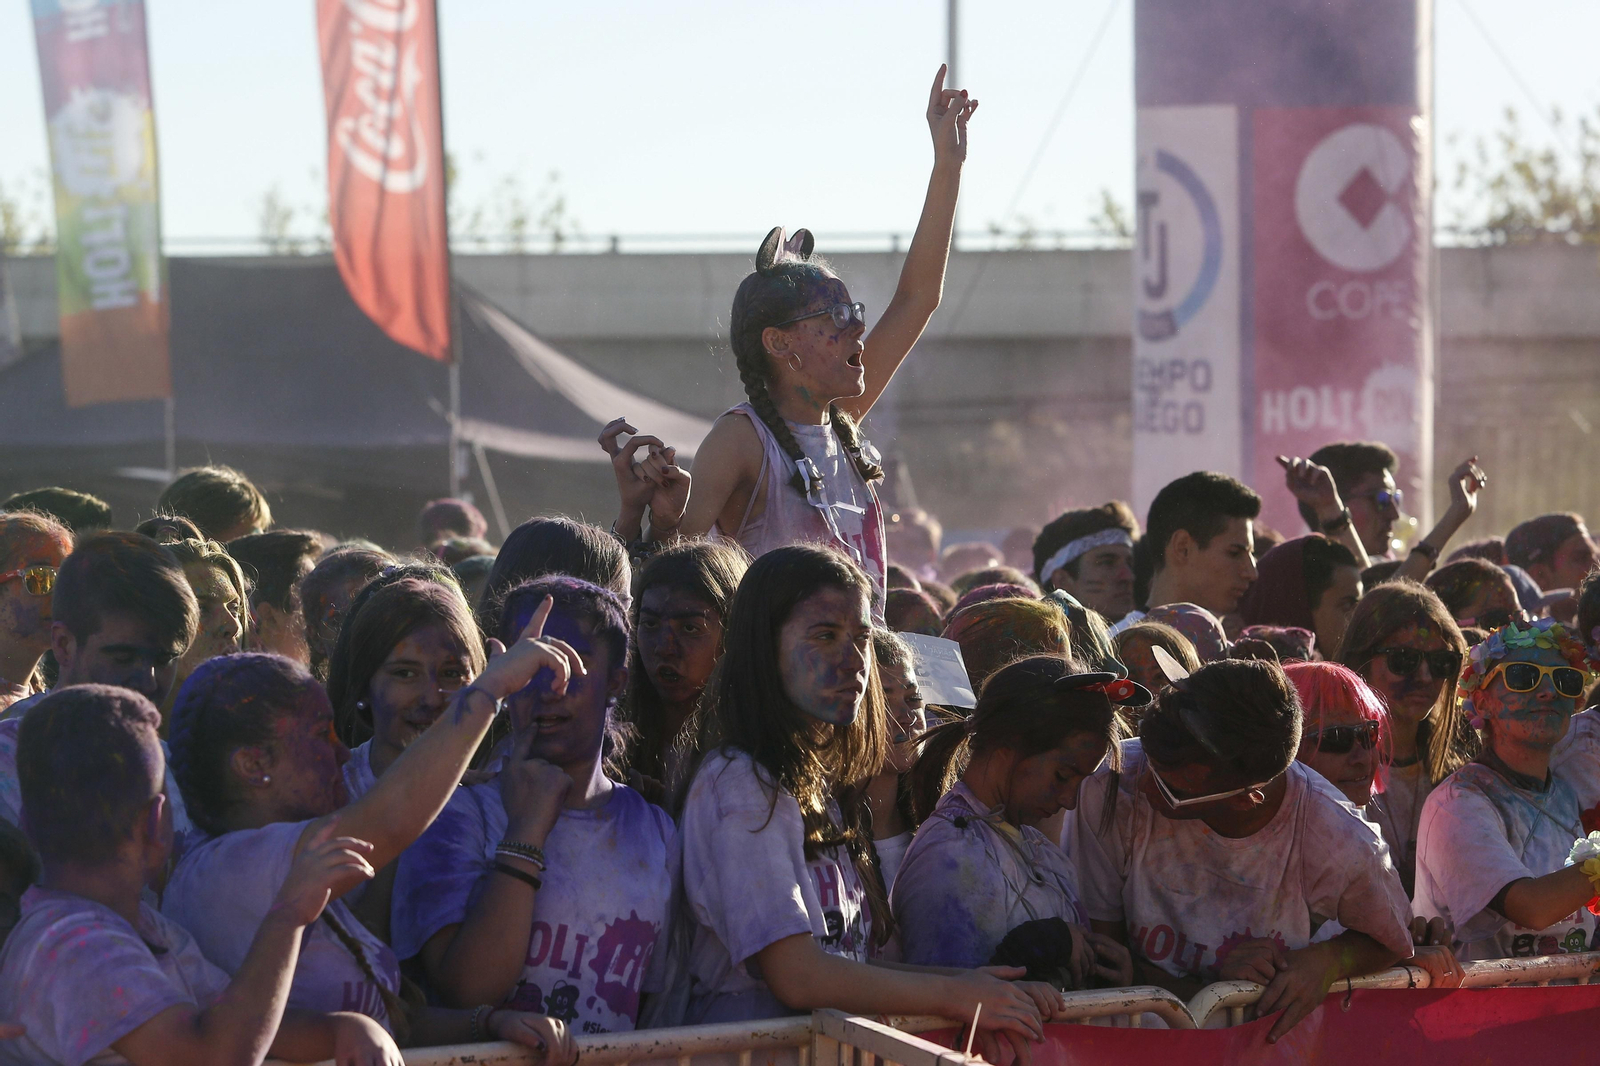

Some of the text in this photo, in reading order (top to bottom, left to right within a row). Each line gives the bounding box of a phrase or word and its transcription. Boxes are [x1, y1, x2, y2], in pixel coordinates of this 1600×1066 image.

[83, 203, 138, 311] HOLI
[1262, 385, 1354, 434] HOLI
[525, 920, 589, 980] OLI
